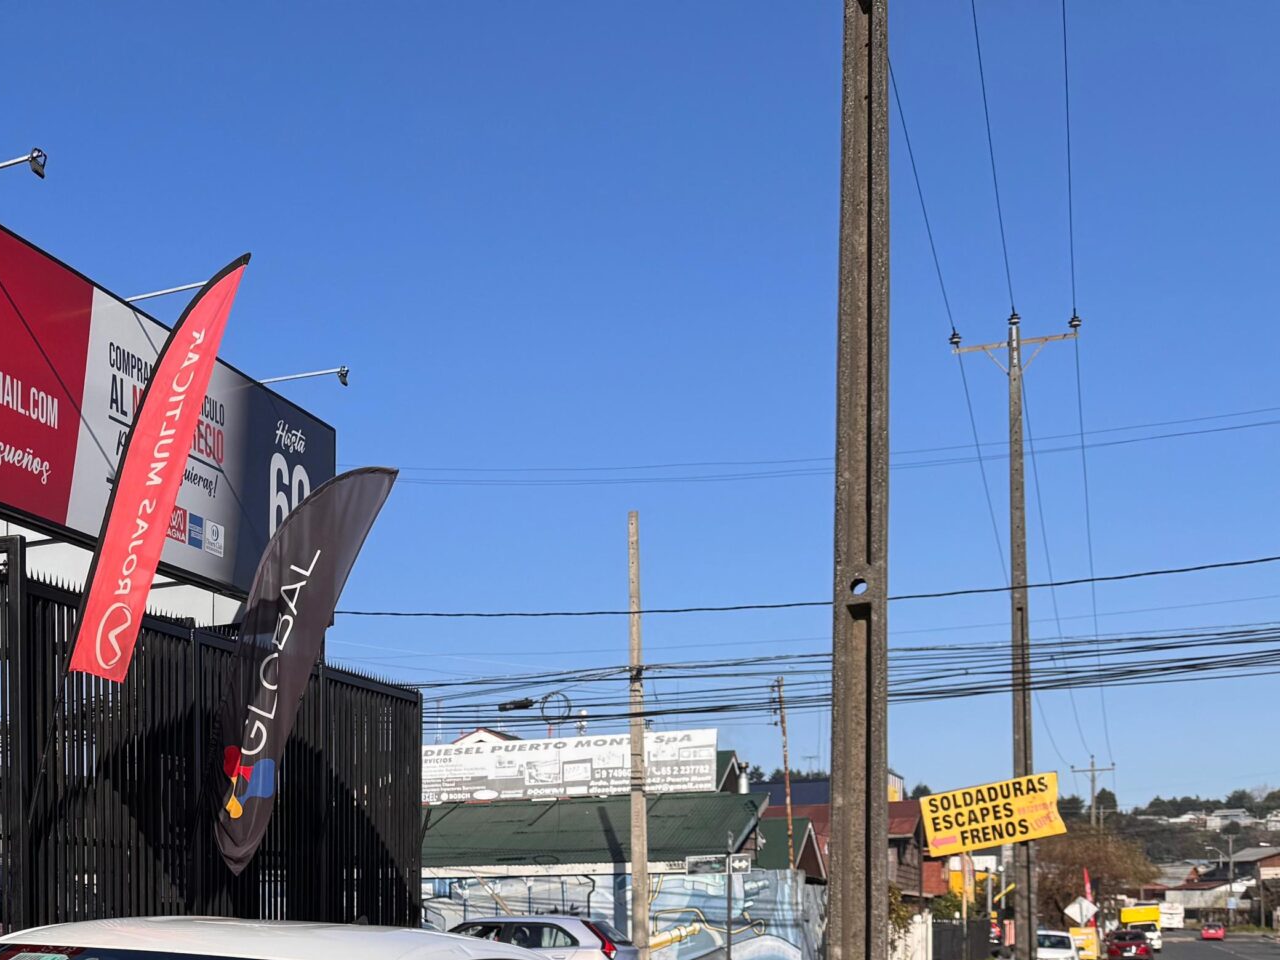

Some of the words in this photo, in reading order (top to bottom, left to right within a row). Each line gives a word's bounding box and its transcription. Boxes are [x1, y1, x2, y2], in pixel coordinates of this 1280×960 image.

[109, 342, 154, 385] COMPRA
[109, 373, 128, 417] AL
[200, 395, 225, 427] CULO
[192, 419, 224, 464] ECIO
[275, 420, 306, 454] Hasta
[180, 467, 219, 497] uieras!
[166, 528, 186, 542] AGNA
[241, 549, 321, 756] GLOBAL
[423, 746, 484, 757] DIESEL
[490, 741, 568, 754] PUERTO
[654, 733, 692, 745] SpA
[928, 776, 1048, 814] SOLDADURAS
[931, 802, 1014, 832] ESCAPES
[960, 819, 1029, 846] FRENOS
